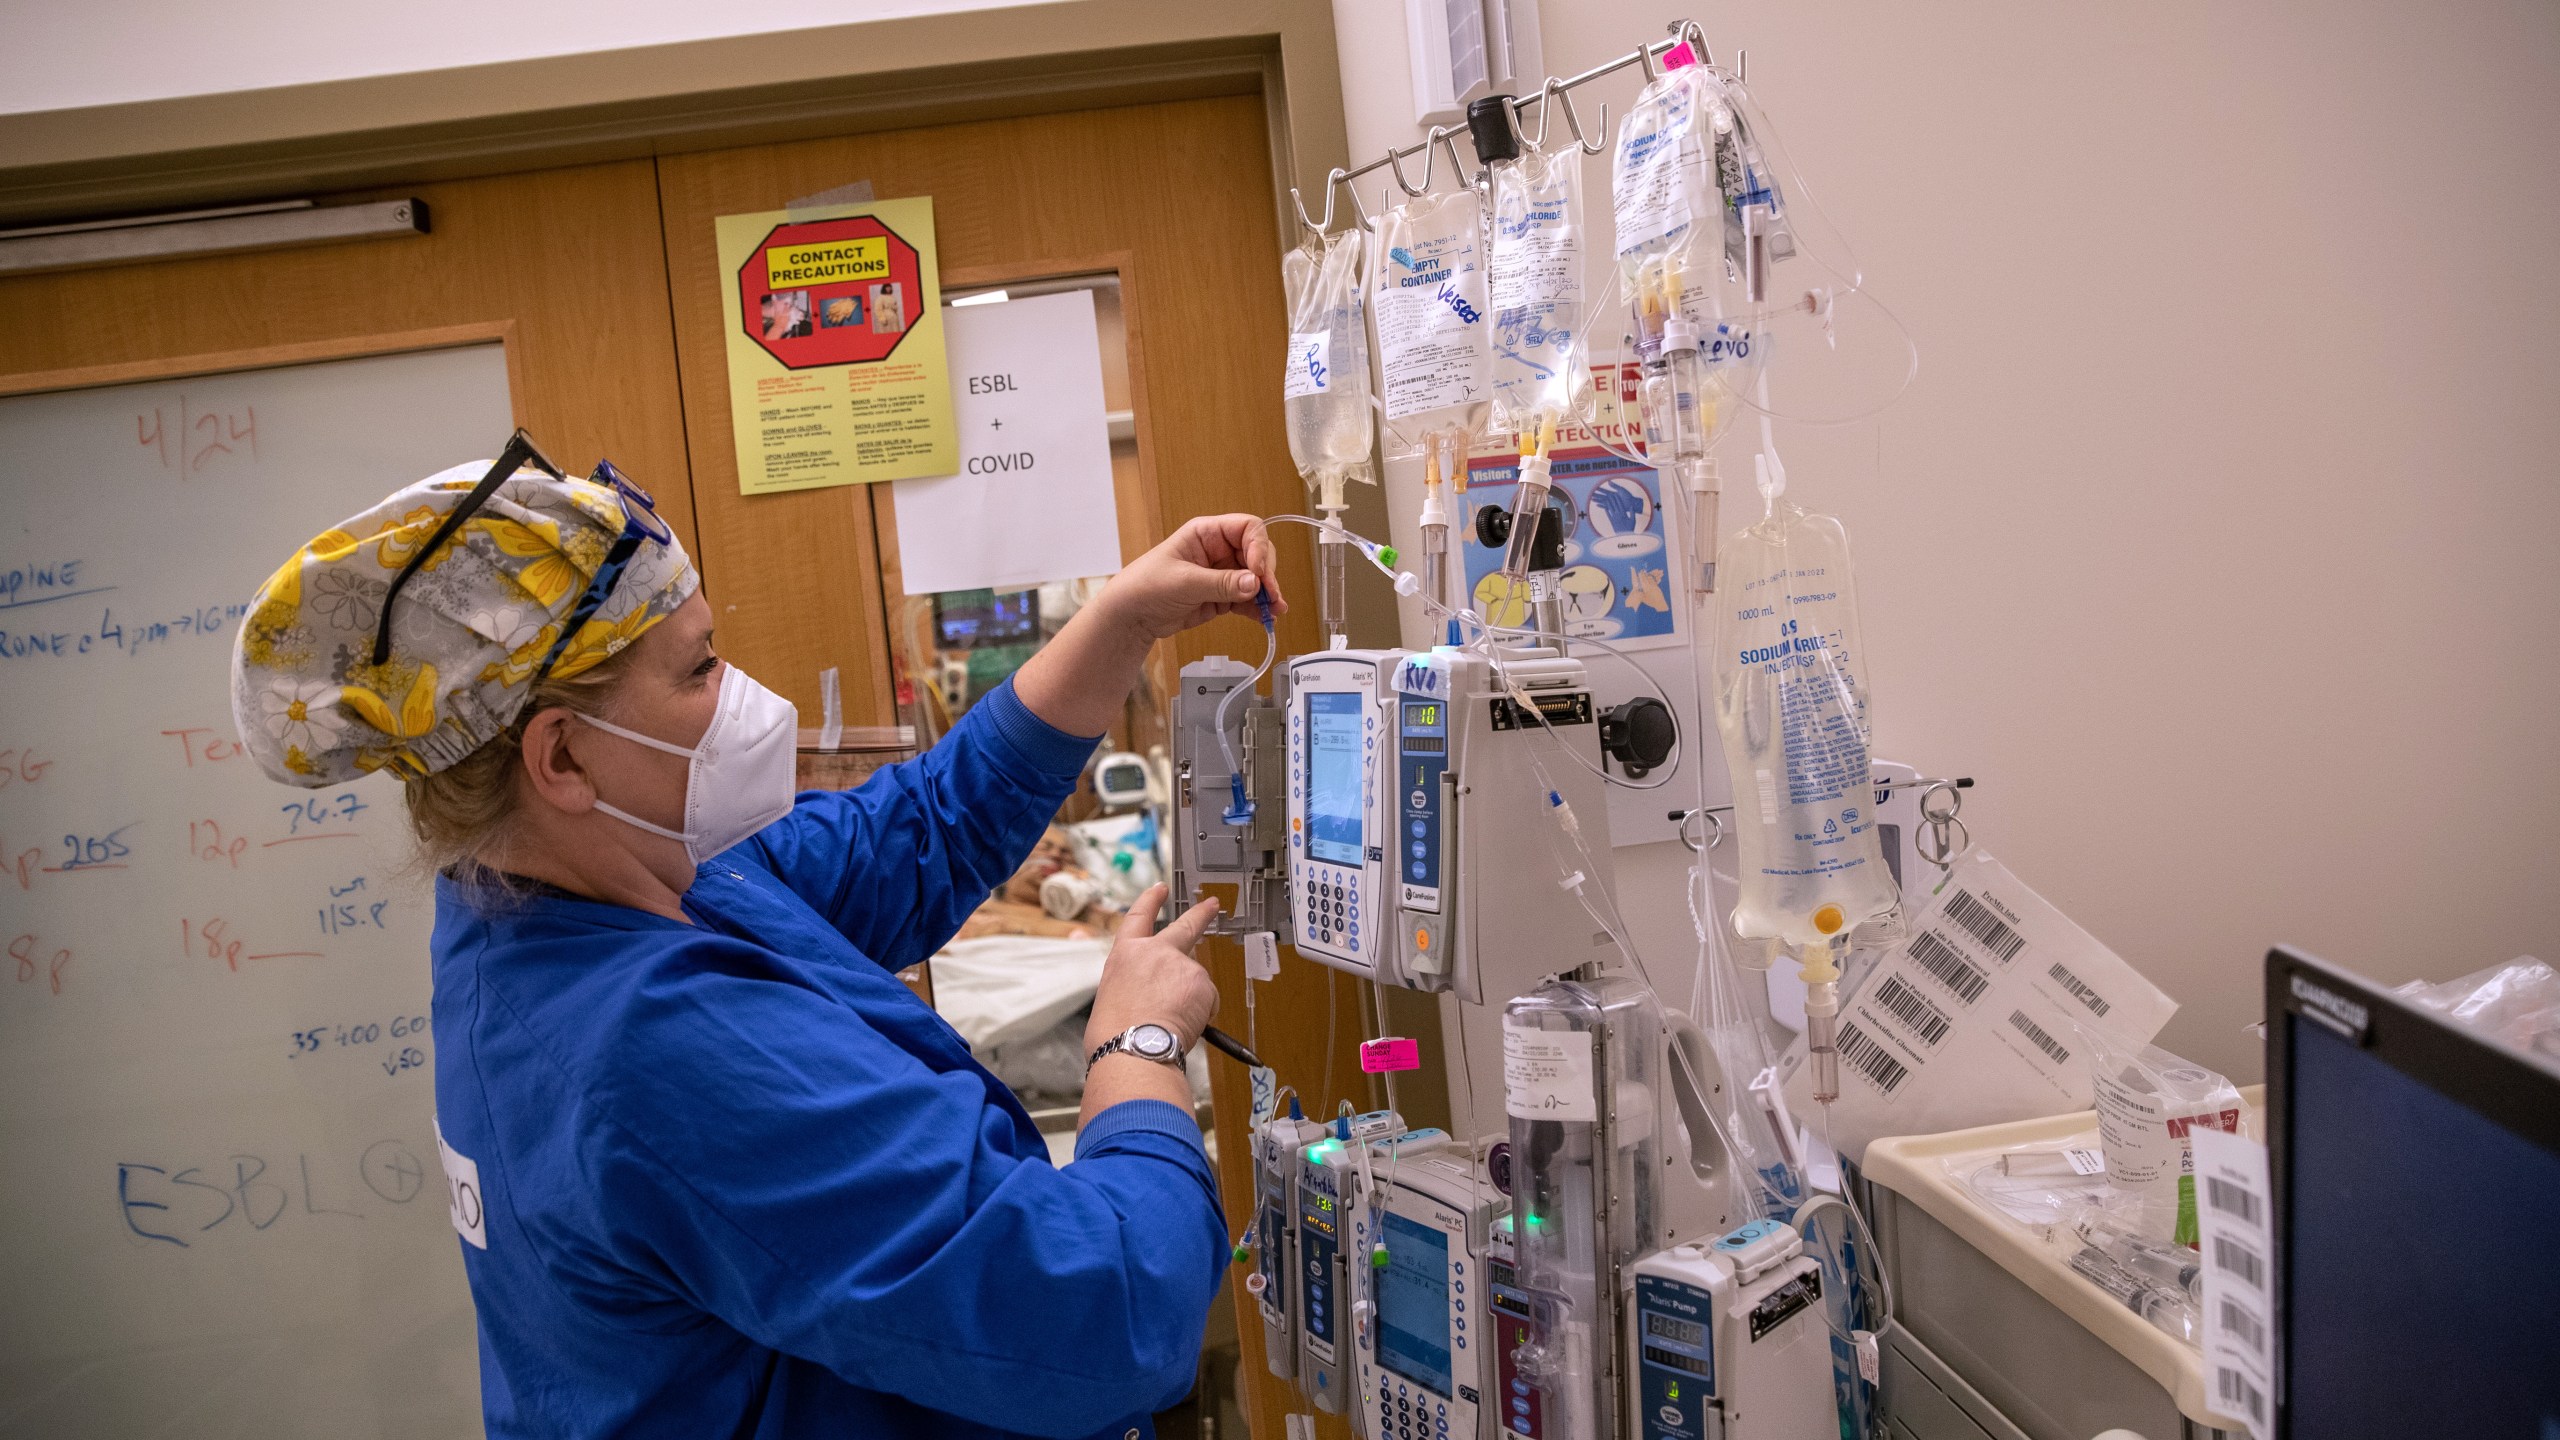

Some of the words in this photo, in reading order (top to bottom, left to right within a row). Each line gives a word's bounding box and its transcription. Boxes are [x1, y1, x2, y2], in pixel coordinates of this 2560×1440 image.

[790, 246, 865, 265] CONTACT
[1412, 258, 1440, 274] EMPTY
[772, 259, 885, 282] PRECAUTIONS
[1401, 269, 1452, 288] CONTAINER
[969, 373, 1018, 395] ESBL
[137, 394, 258, 482] 4/24
[968, 452, 1034, 475] COVID
[1471, 469, 1512, 483] Visitors
[1738, 608, 1759, 620] 1000
[1740, 639, 1791, 665] SODIUM
[1406, 662, 1436, 692] KVO
[1421, 706, 1435, 725] 10
[1412, 891, 1436, 901] CareFusion
[2004, 908, 2021, 925] label
[1932, 927, 1947, 942] Lido
[1946, 939, 1965, 958] Patch
[1964, 953, 1991, 978] Removal
[1894, 970, 1910, 988] Nitro
[1909, 984, 1927, 1002] Patch
[1926, 997, 1953, 1023] Removal
[1857, 1005, 1897, 1041] Chlorhexidine
[1896, 1037, 1926, 1066] Gluconate
[117, 1153, 365, 1249] ESBL
[1672, 1301, 1698, 1314] Pump
